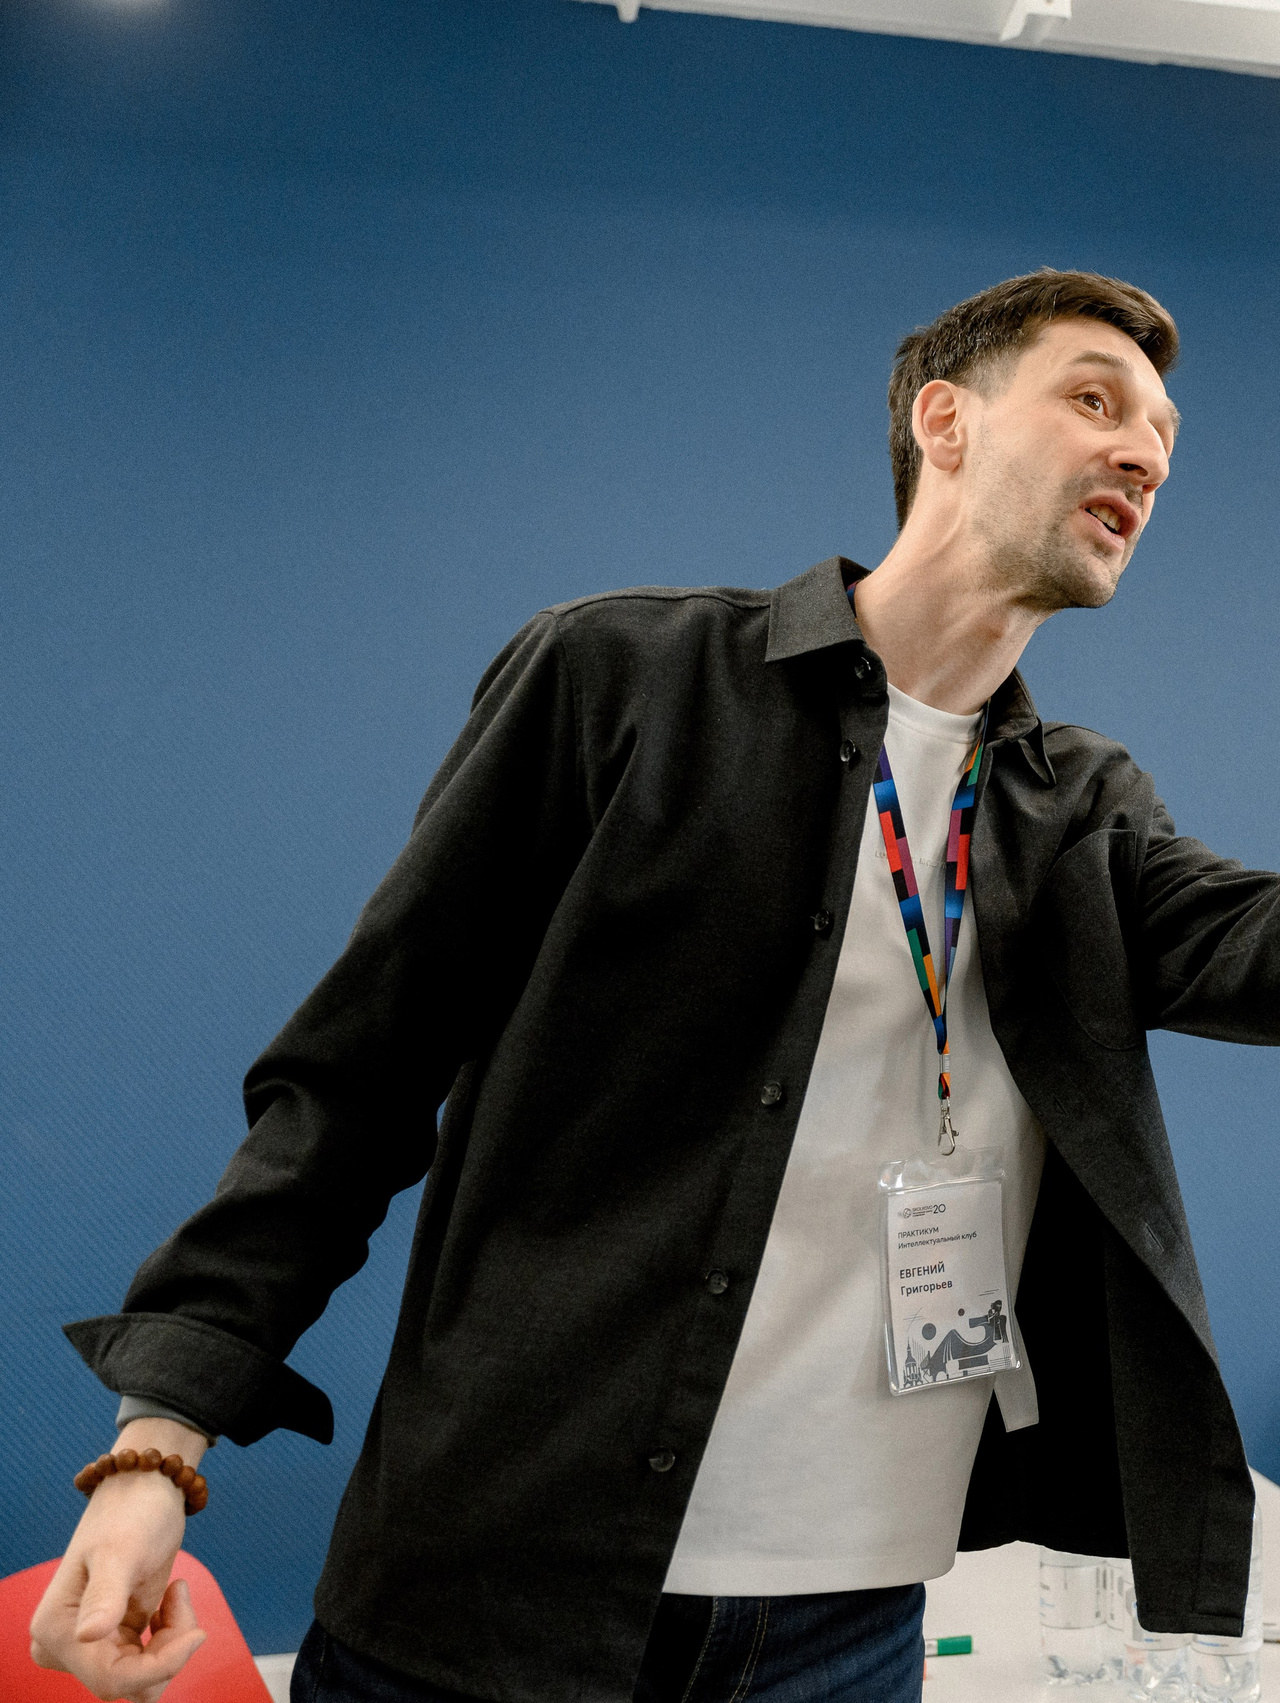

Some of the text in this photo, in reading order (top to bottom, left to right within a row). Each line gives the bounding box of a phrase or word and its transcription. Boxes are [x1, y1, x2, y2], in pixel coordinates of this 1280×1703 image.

[933, 1203, 947, 1214] 20
[898, 1227, 939, 1239] ПРАКТИКУМ
[898, 1231, 977, 1249] Интеллектуальный клуб
[900, 1261, 945, 1279] ЕВГЕНИЙ
[900, 1280, 953, 1297] Григорьев
